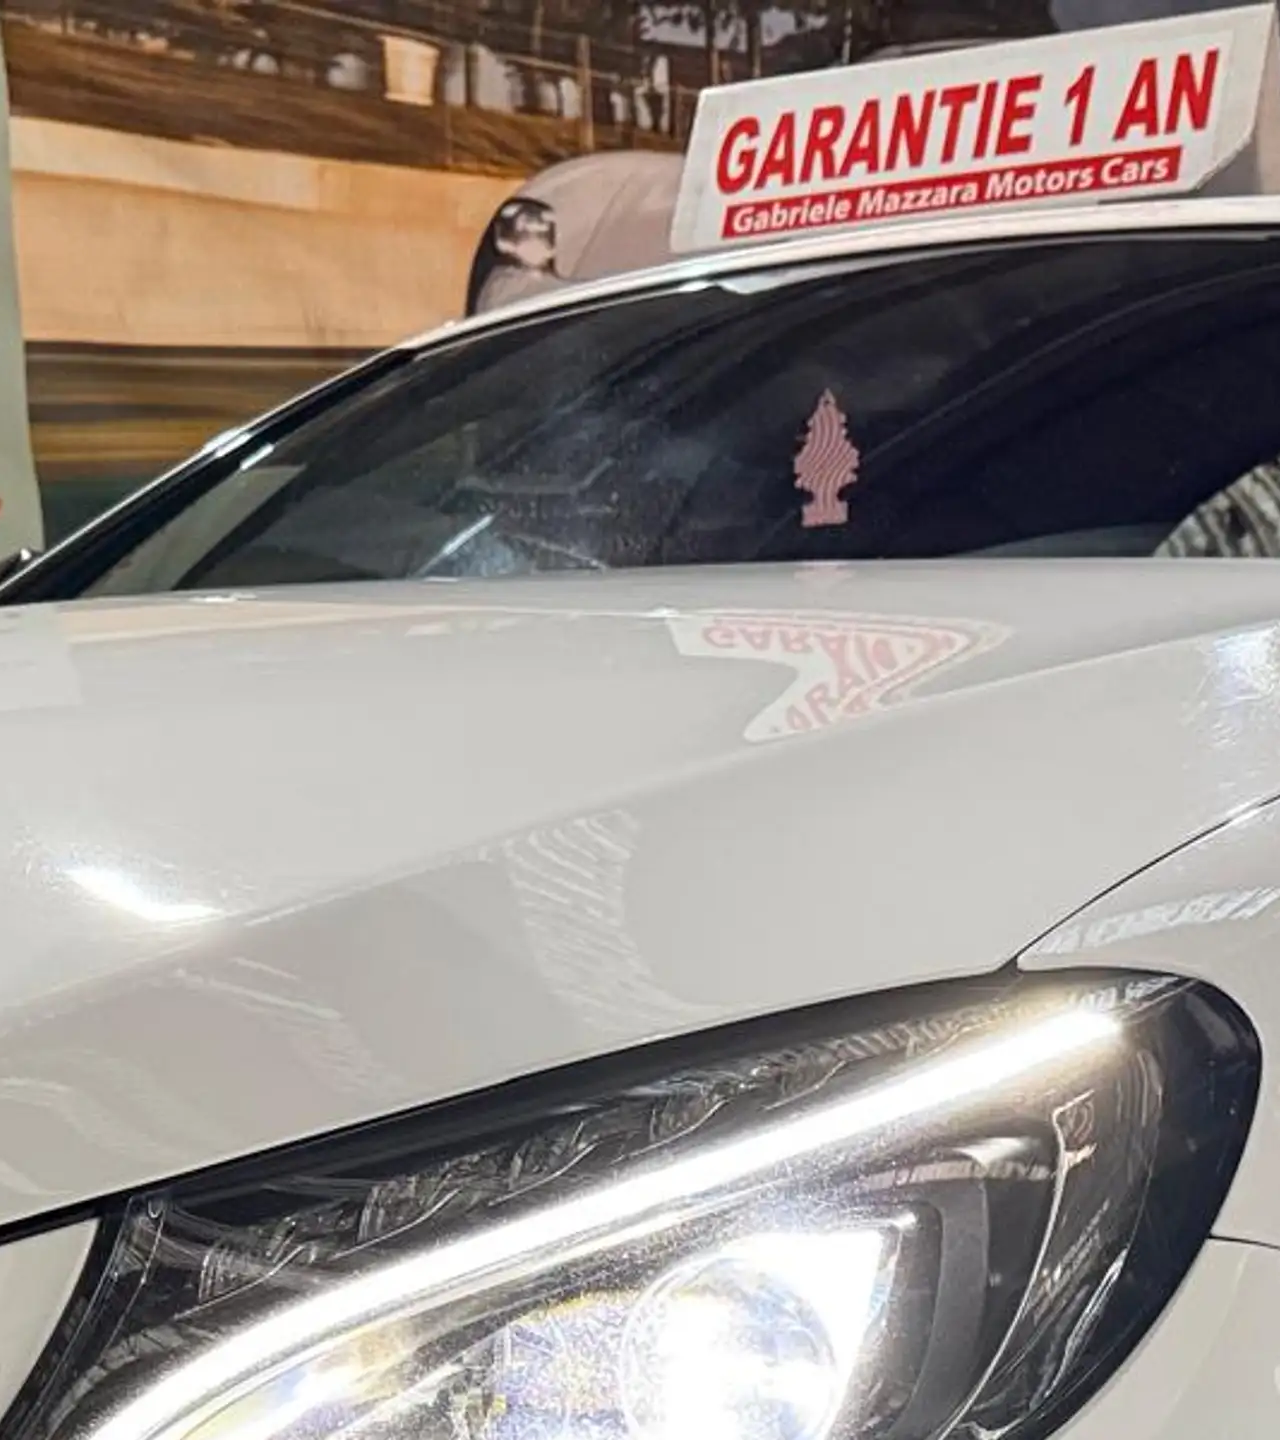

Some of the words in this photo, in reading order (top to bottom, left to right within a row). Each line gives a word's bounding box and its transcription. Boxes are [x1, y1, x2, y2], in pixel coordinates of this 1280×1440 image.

[715, 74, 1043, 195] GARANTIE
[1064, 65, 1095, 146] 1
[1112, 49, 1220, 141] AN
[731, 197, 850, 234] Gabriele
[856, 179, 978, 217] Mazzara
[984, 166, 1094, 201] Motors
[1100, 155, 1170, 185] Cars
